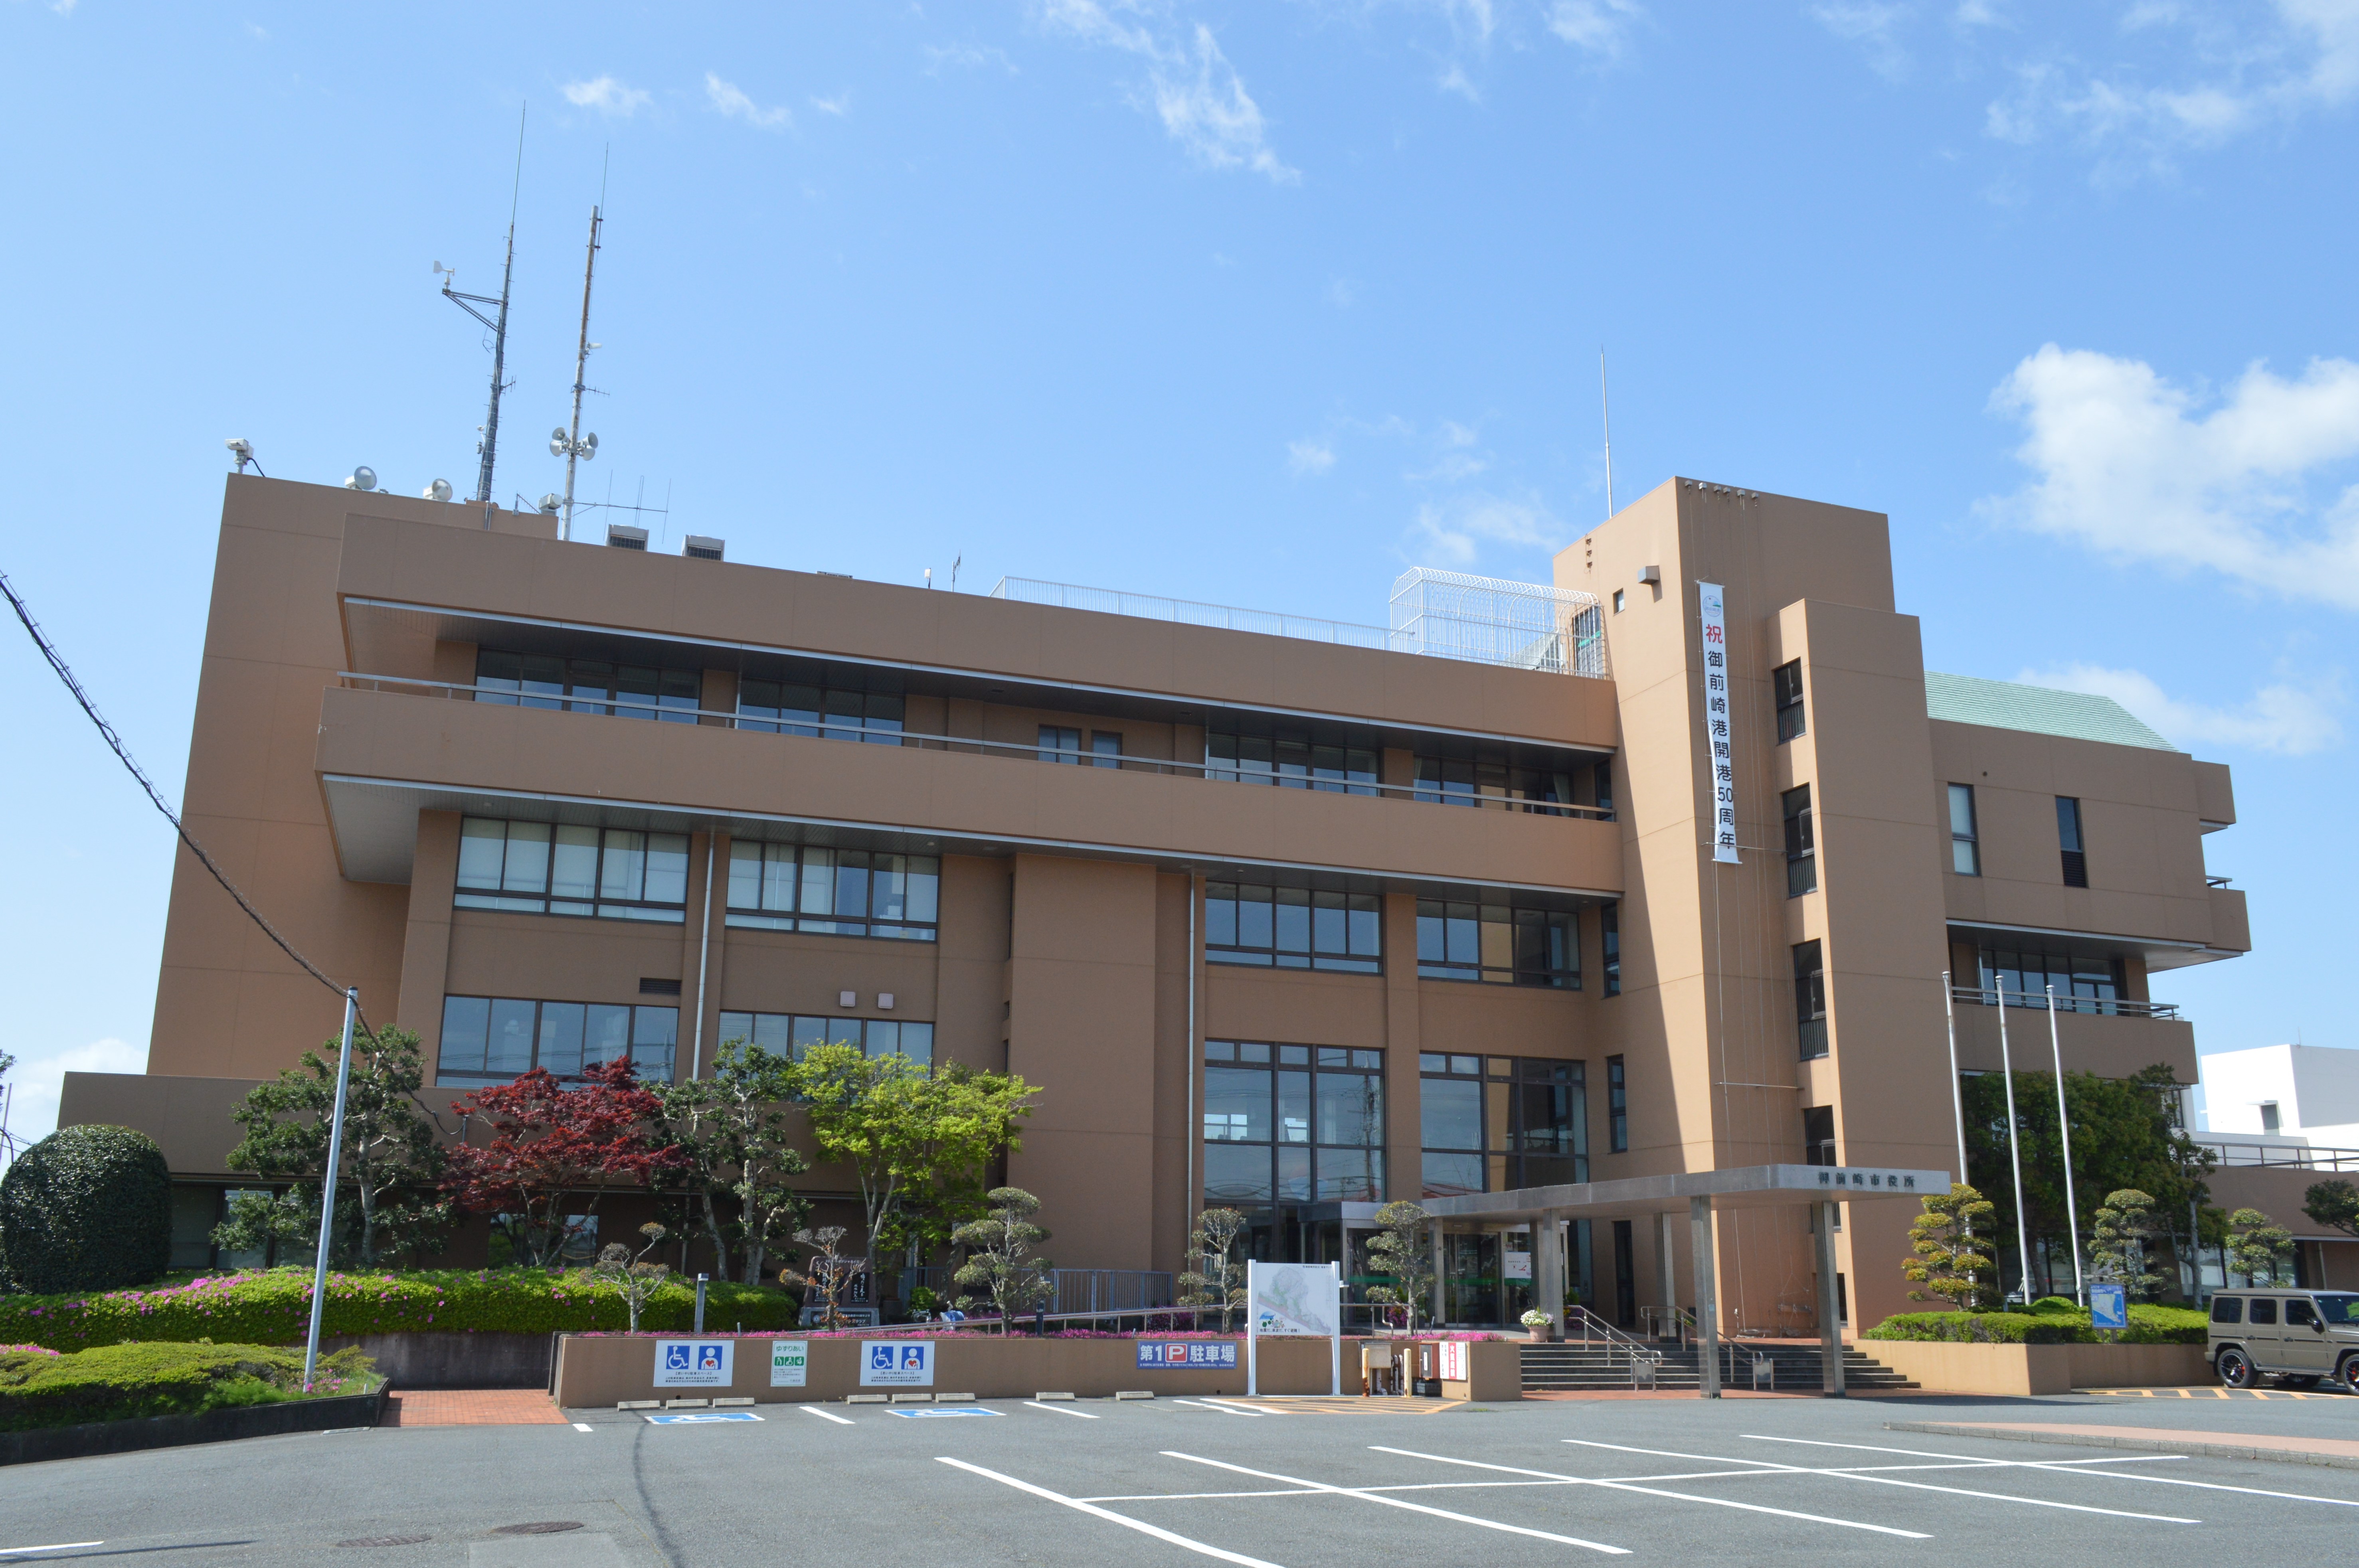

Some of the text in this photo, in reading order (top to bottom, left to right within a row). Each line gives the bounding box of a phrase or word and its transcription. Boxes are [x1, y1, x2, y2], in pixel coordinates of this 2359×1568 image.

[1818, 1172, 1916, 1188] 御前崎市役所
